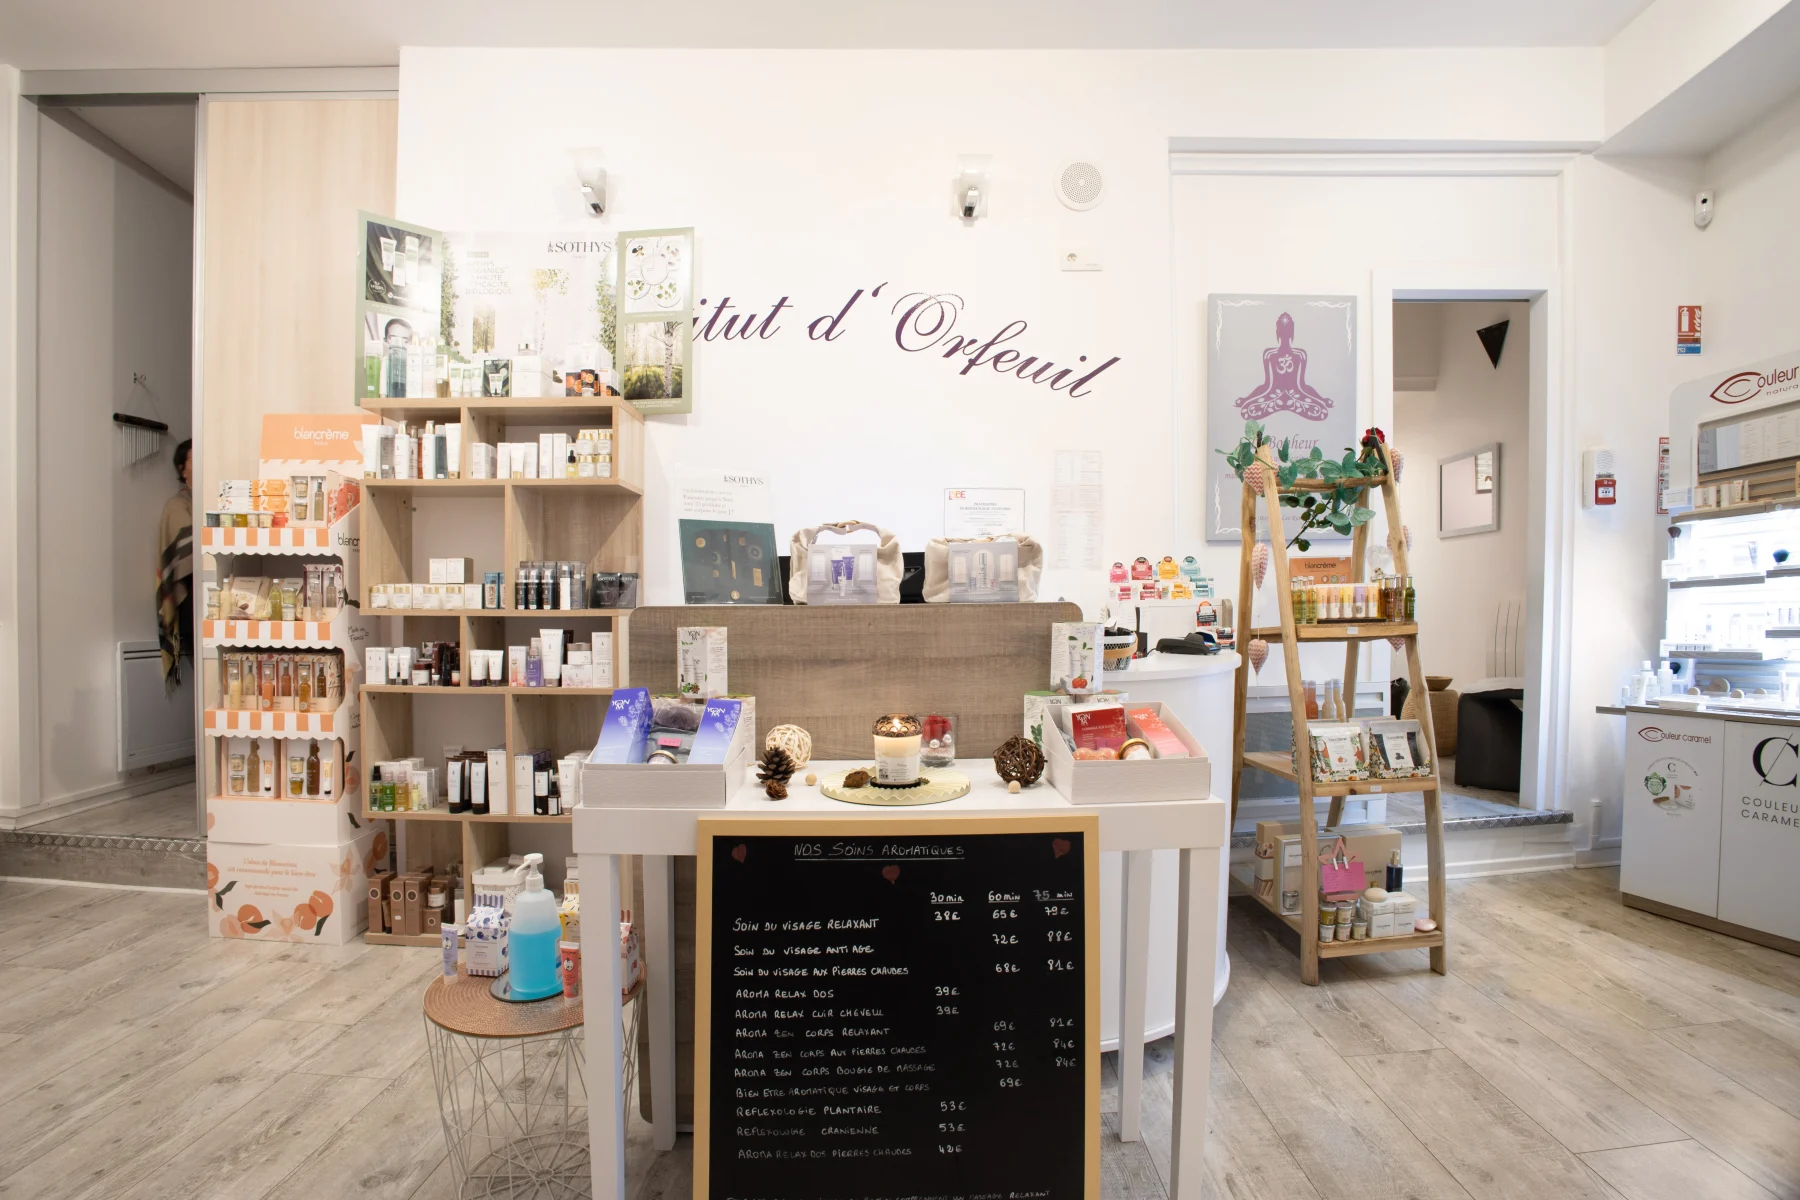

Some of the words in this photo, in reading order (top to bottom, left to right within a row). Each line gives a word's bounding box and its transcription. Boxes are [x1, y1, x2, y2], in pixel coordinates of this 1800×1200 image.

[555, 241, 612, 252] SOTHYS
[294, 426, 349, 441] blancrème
[795, 843, 821, 855] NOS
[829, 842, 873, 855] SOINS
[882, 845, 964, 855] AROMATIQUES
[733, 918, 758, 931] SOIN
[764, 922, 777, 931] DU
[783, 921, 821, 930] VISAGE
[828, 919, 879, 929] RELAXANT
[734, 945, 754, 955] SOIN
[853, 945, 874, 953] AGE
[734, 967, 753, 976] SOIN
[773, 968, 808, 976] VISAGE
[813, 968, 828, 976] AUX
[832, 966, 866, 976] PIERRES
[871, 967, 908, 975] CHAUDES
[736, 989, 769, 998] AROMA
[775, 989, 806, 998] RELAX
[814, 990, 833, 998] DOS
[736, 1010, 767, 1018] AROMA
[775, 1010, 803, 1018] RELAX
[736, 1028, 766, 1037] AROMA
[806, 1029, 833, 1037] CORPS
[842, 1028, 889, 1036] RELAXANT
[735, 1049, 763, 1058] AROMA
[735, 1068, 766, 1077] AROMA
[802, 1067, 829, 1075] CORPS
[897, 1064, 935, 1072] MASSAGE
[736, 1088, 758, 1097] BIEN
[824, 1105, 881, 1114] PLANTAIRE
[739, 1150, 772, 1159] AROMA
[776, 1150, 806, 1158] RELAX
[811, 1150, 825, 1158] DOS
[832, 1149, 869, 1157] PIERRES
[1010, 1190, 1050, 1199] RELAXANT
